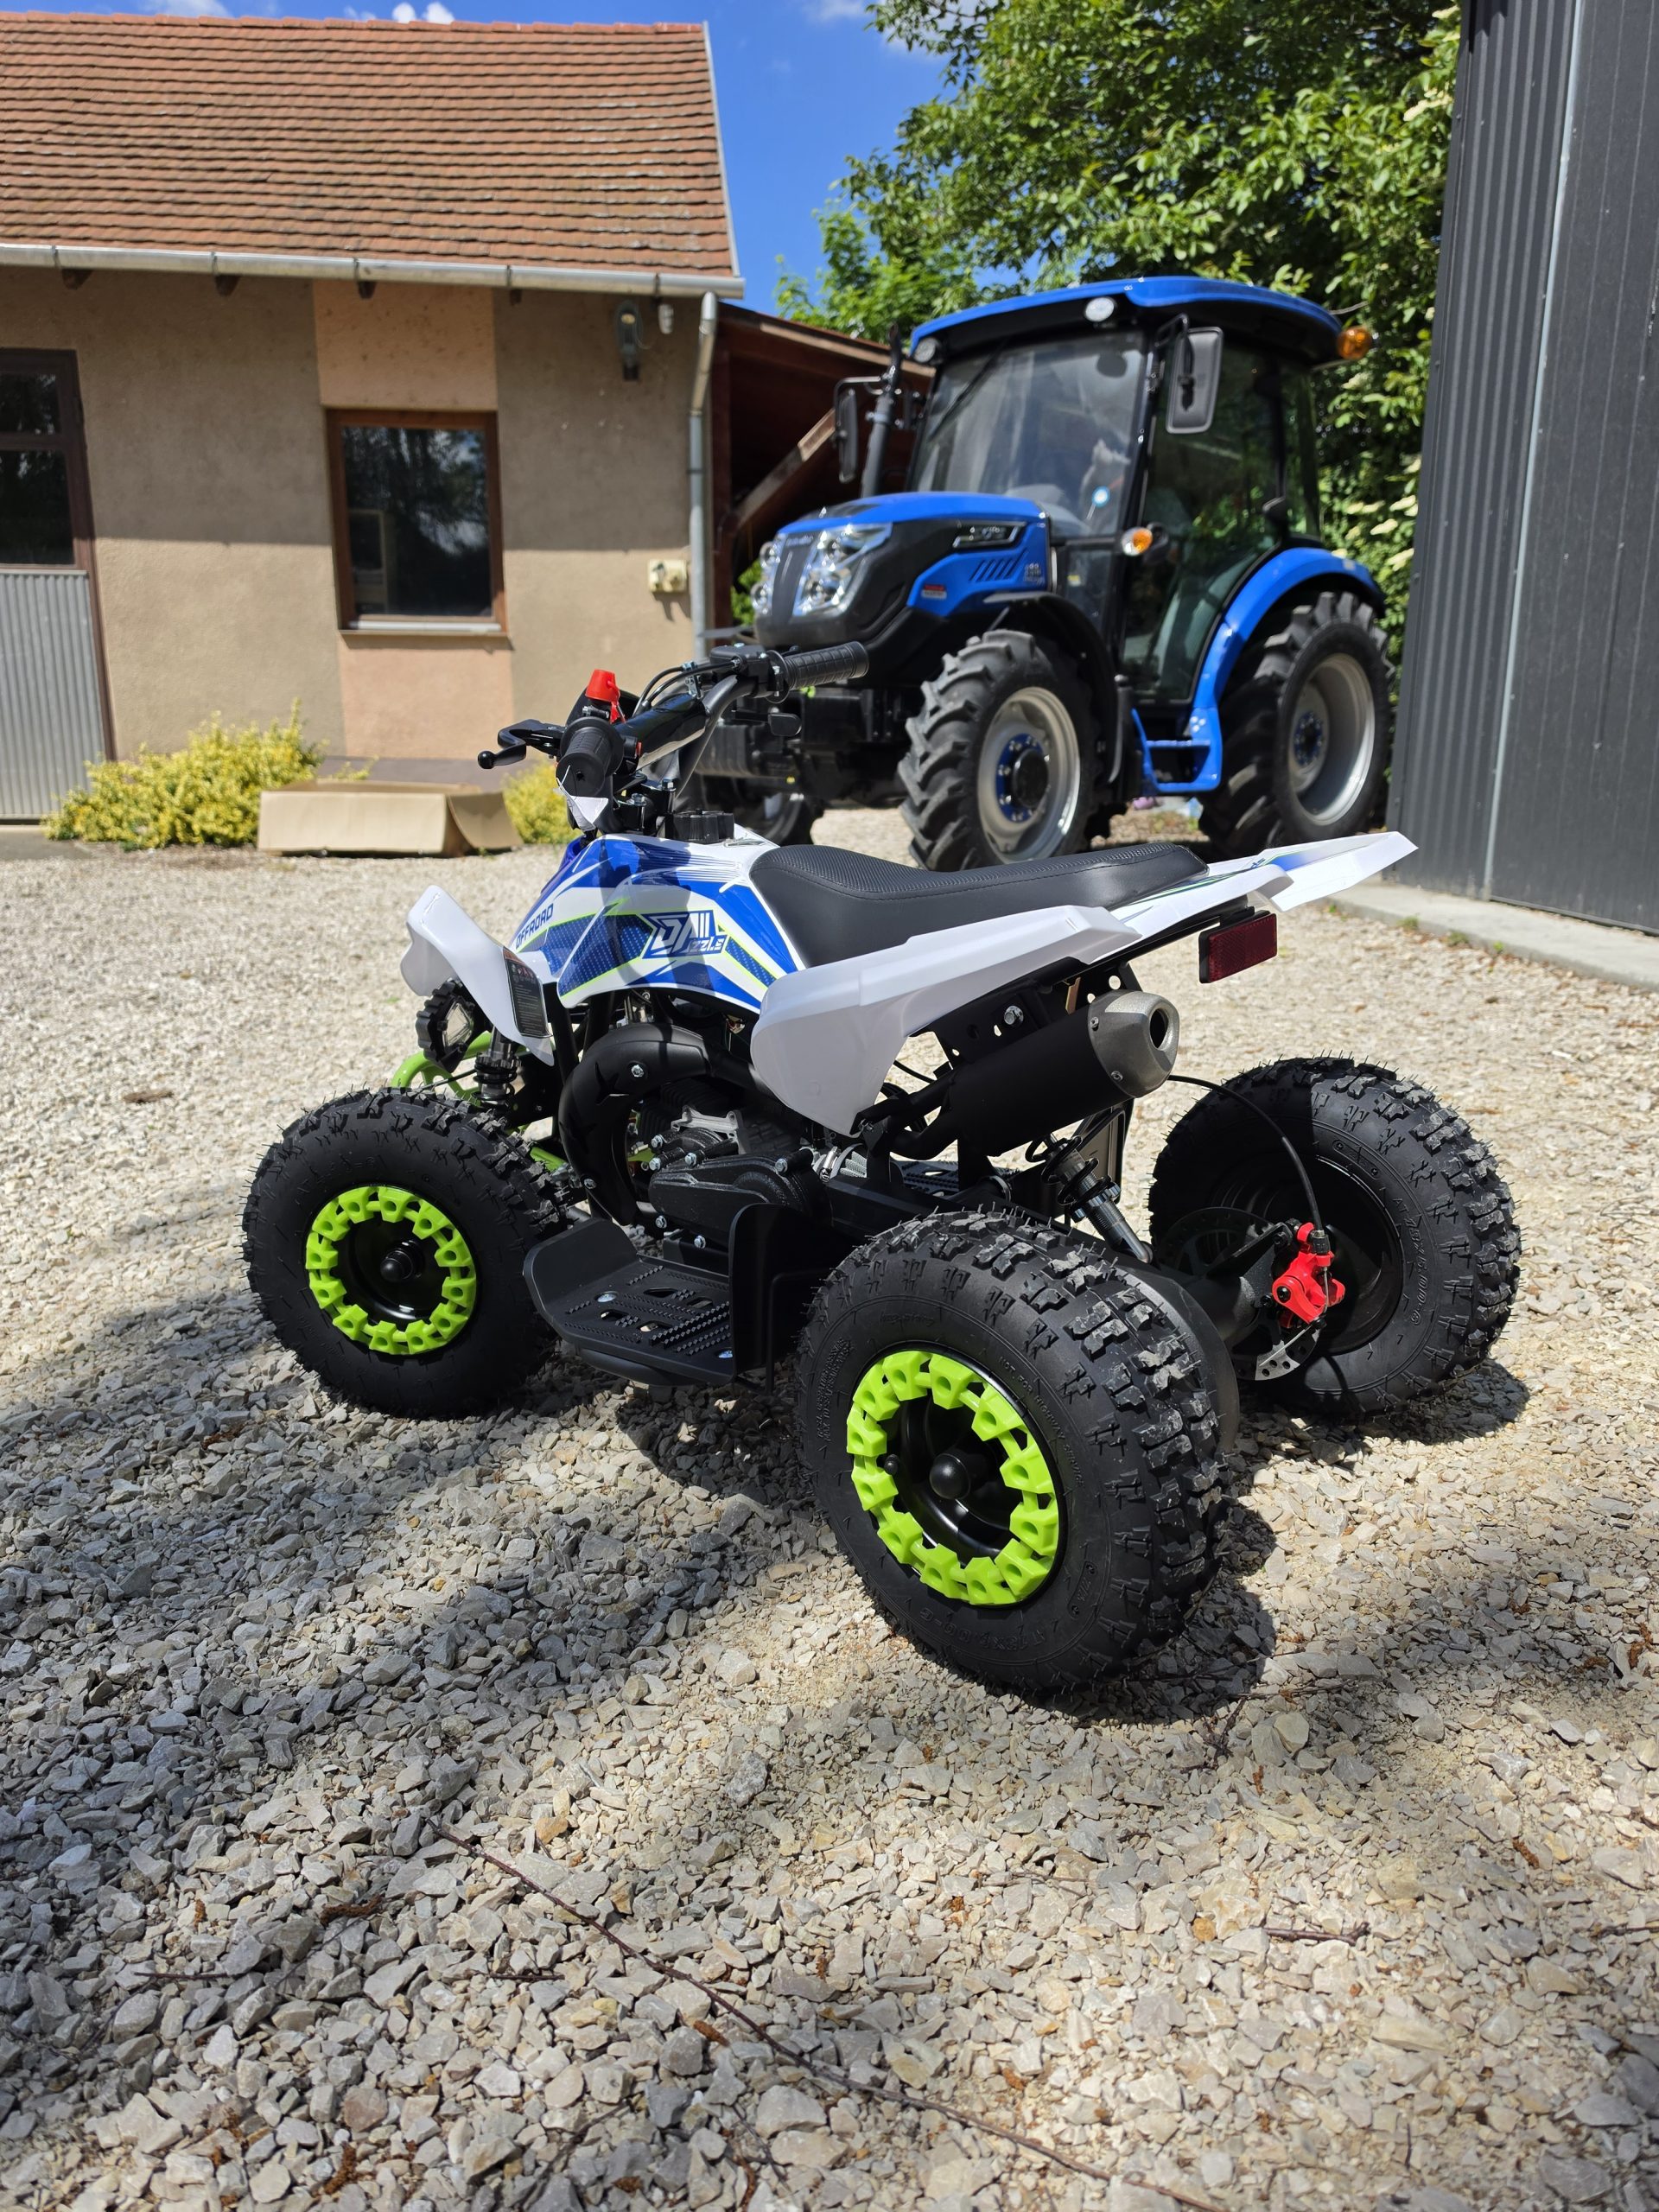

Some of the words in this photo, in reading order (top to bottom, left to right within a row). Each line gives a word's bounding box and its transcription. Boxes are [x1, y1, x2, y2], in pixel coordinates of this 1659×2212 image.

[515, 903, 554, 950] OFFROAD
[998, 1356, 1016, 1374] NOT
[1019, 1375, 1034, 1394] FOR
[1034, 1395, 1065, 1440] HIGHWAY
